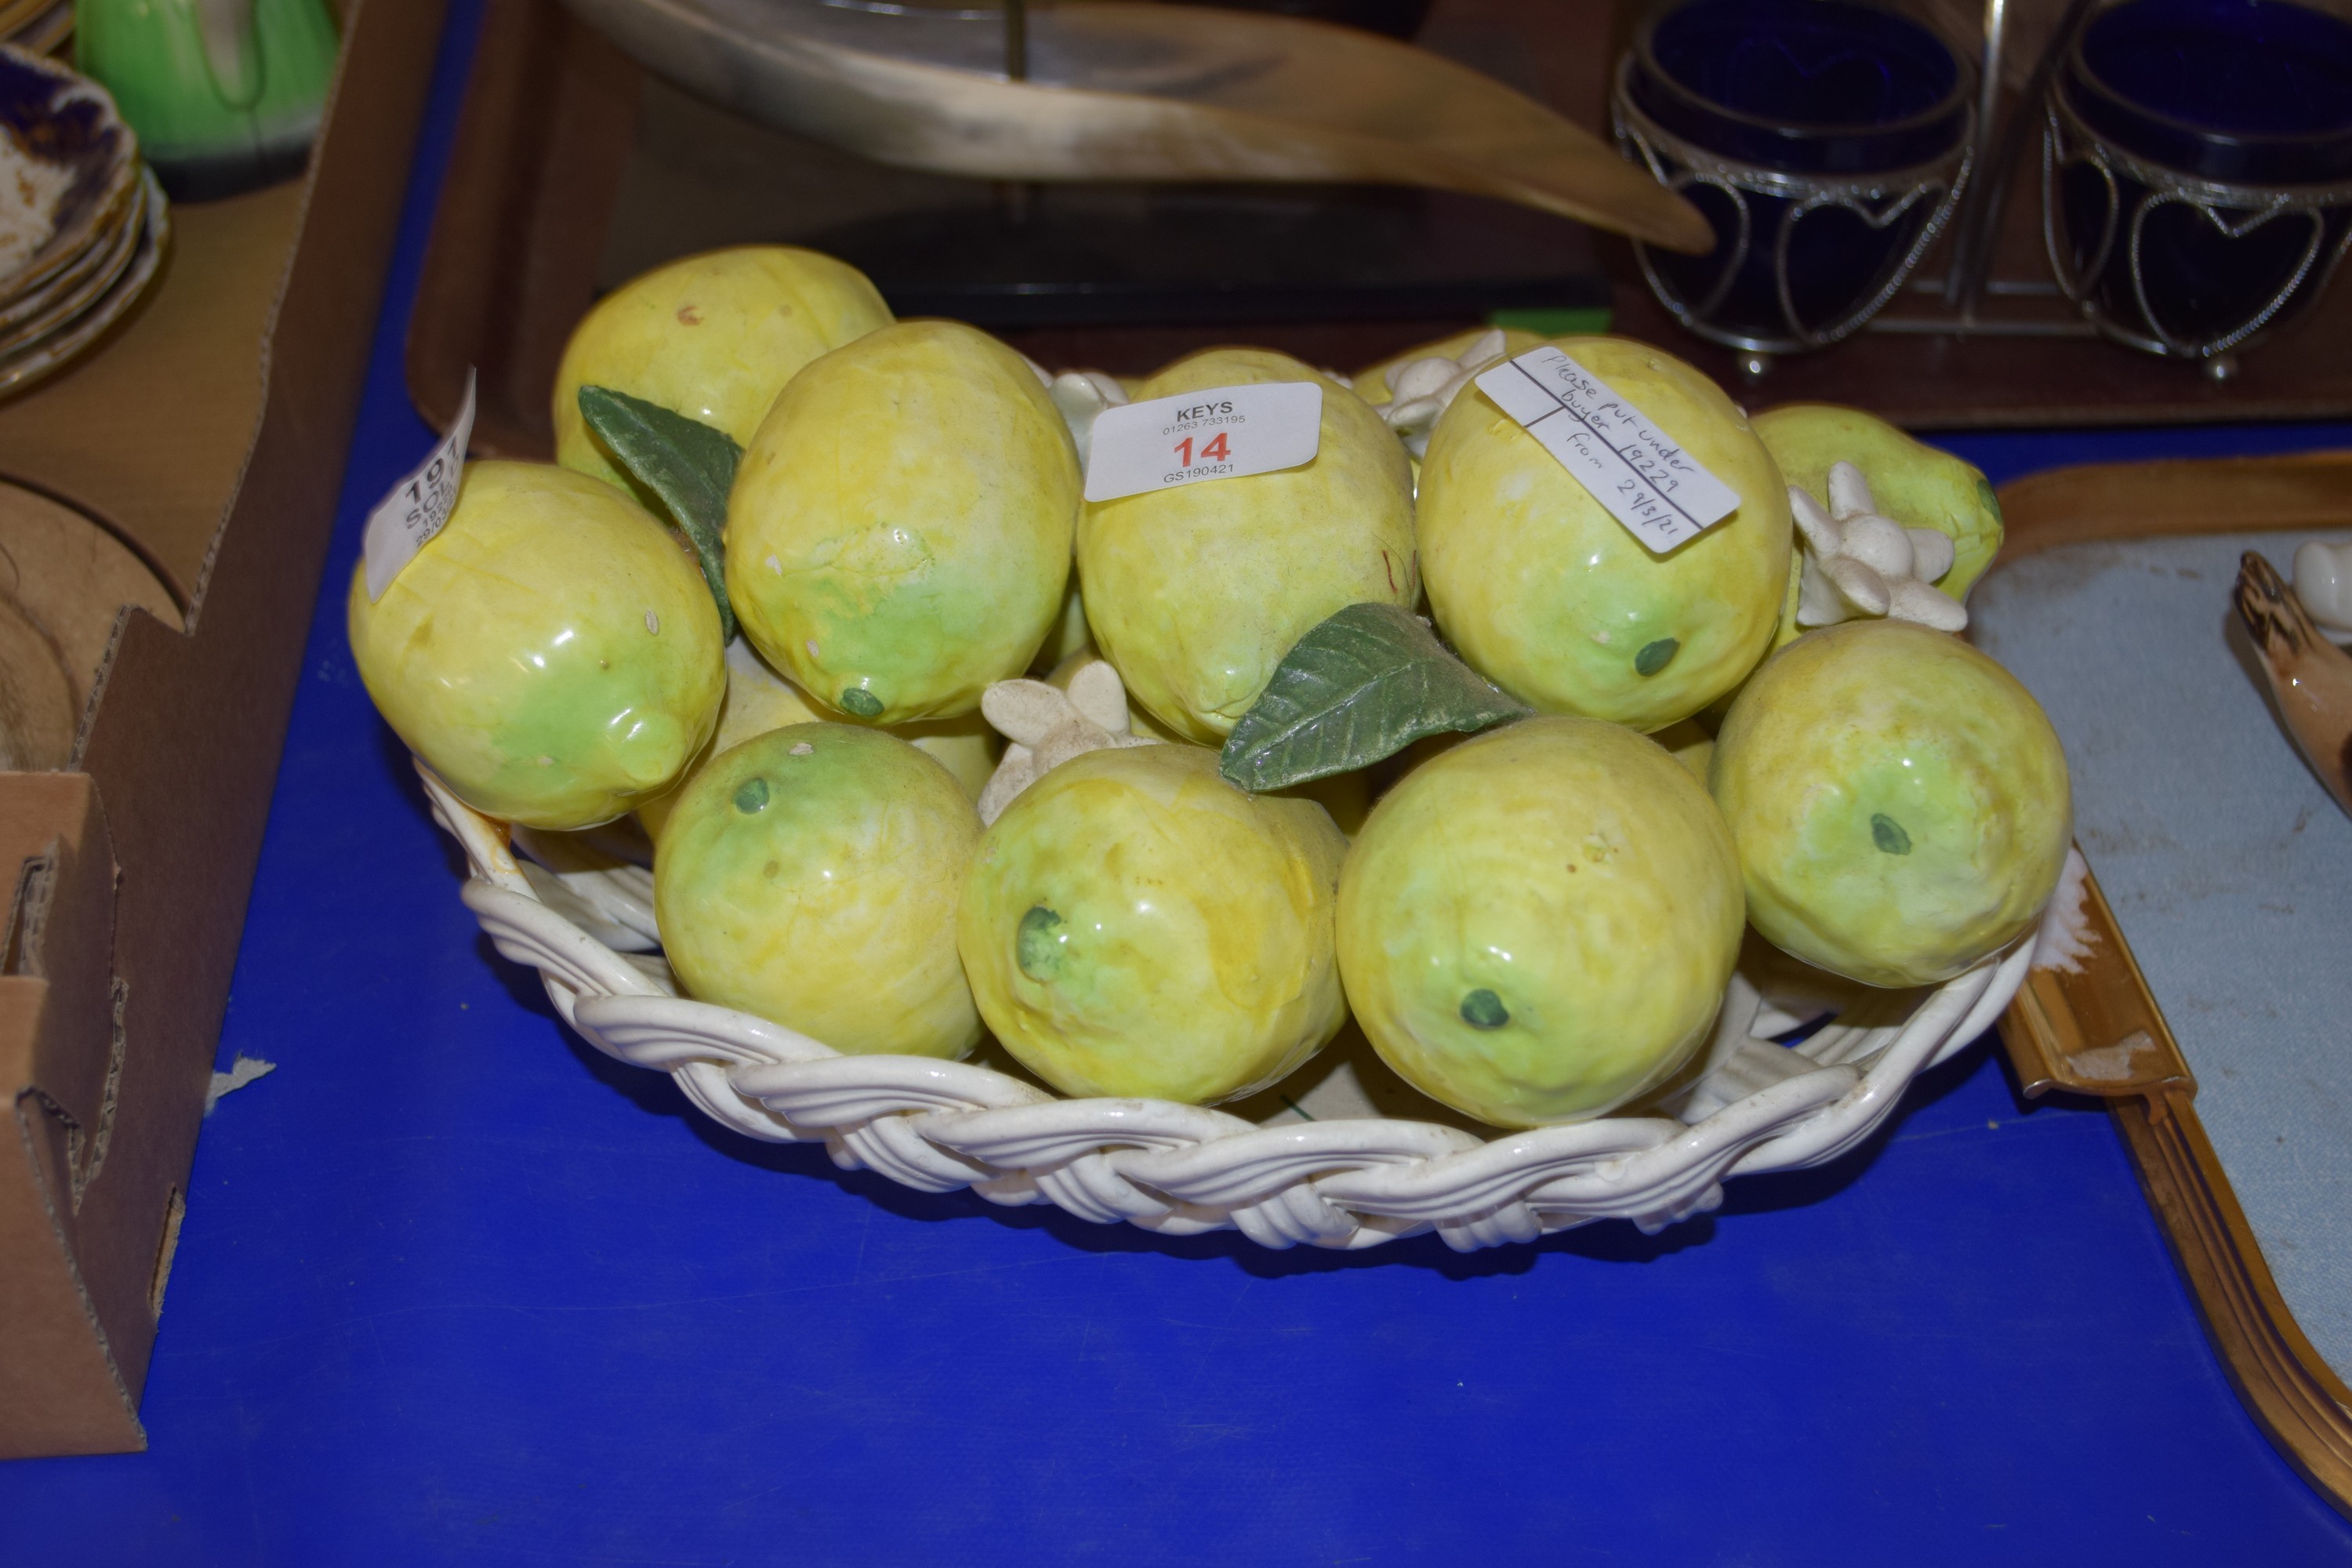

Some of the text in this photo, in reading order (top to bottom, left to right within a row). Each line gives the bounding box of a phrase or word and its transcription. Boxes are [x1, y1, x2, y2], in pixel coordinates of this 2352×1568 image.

[1163, 416, 1246, 435] 01263 733195
[1177, 401, 1233, 422] KEYS
[1542, 355, 1694, 472] Please put under
[1174, 433, 1232, 467] 14
[1561, 390, 1679, 493] buyer 19229
[405, 436, 456, 504] 191
[406, 454, 459, 529] SOLD
[1163, 463, 1233, 483] GS190421
[1617, 479, 1678, 535] 29/3/21
